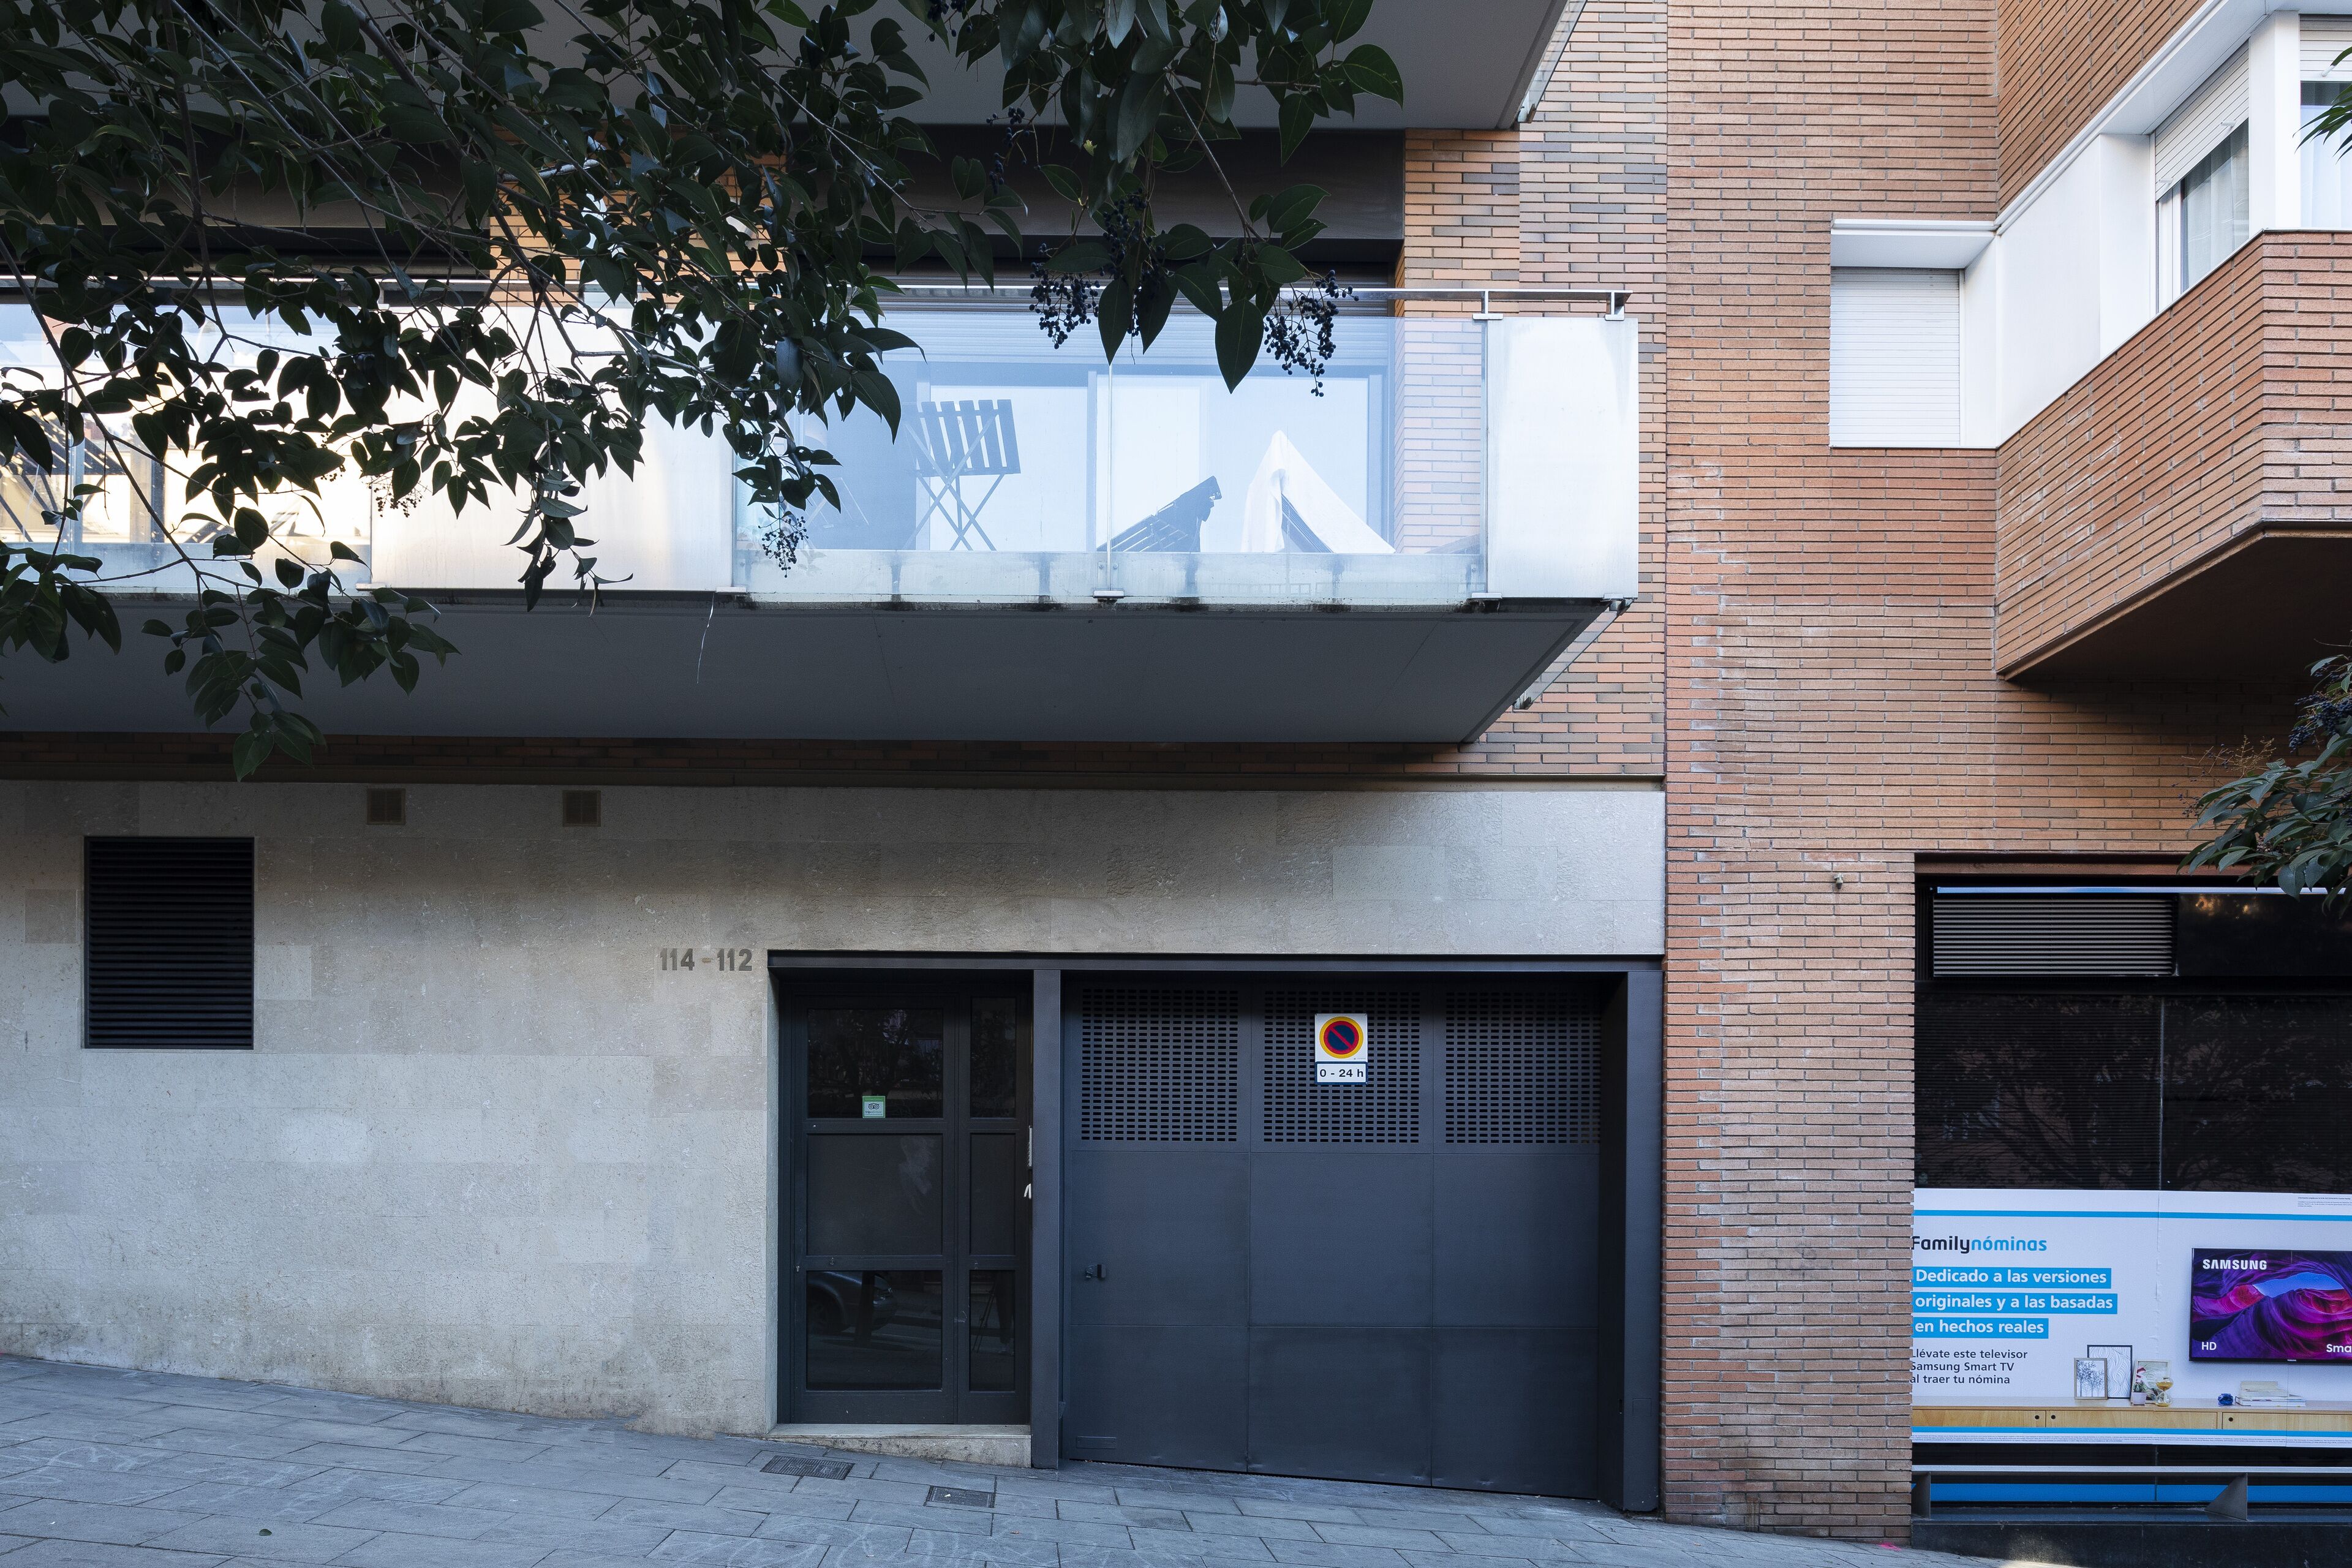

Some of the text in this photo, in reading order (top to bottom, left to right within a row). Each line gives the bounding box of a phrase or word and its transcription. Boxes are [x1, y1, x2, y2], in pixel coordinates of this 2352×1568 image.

[660, 948, 695, 971] 114
[717, 949, 752, 971] 112
[1320, 1069, 1327, 1077] 0
[1339, 1069, 1352, 1077] 24
[1357, 1069, 1363, 1077] h
[1911, 1235, 2047, 1254] Familynóminas
[2203, 1259, 2267, 1270] SAMSUNG
[1916, 1268, 2107, 1284] Dedicado a las versiones
[1915, 1294, 2113, 1311] originales y a las basadas
[1915, 1319, 2044, 1333] en hechos reales
[2201, 1341, 2217, 1351] HD
[2326, 1343, 2352, 1353] Sma
[1953, 1350, 1977, 1359] este
[1979, 1349, 2028, 1359] televisor
[1911, 1362, 2015, 1373] Samsung Smart TV
[1910, 1374, 1919, 1384] al
[1969, 1374, 2010, 1384] nómina
